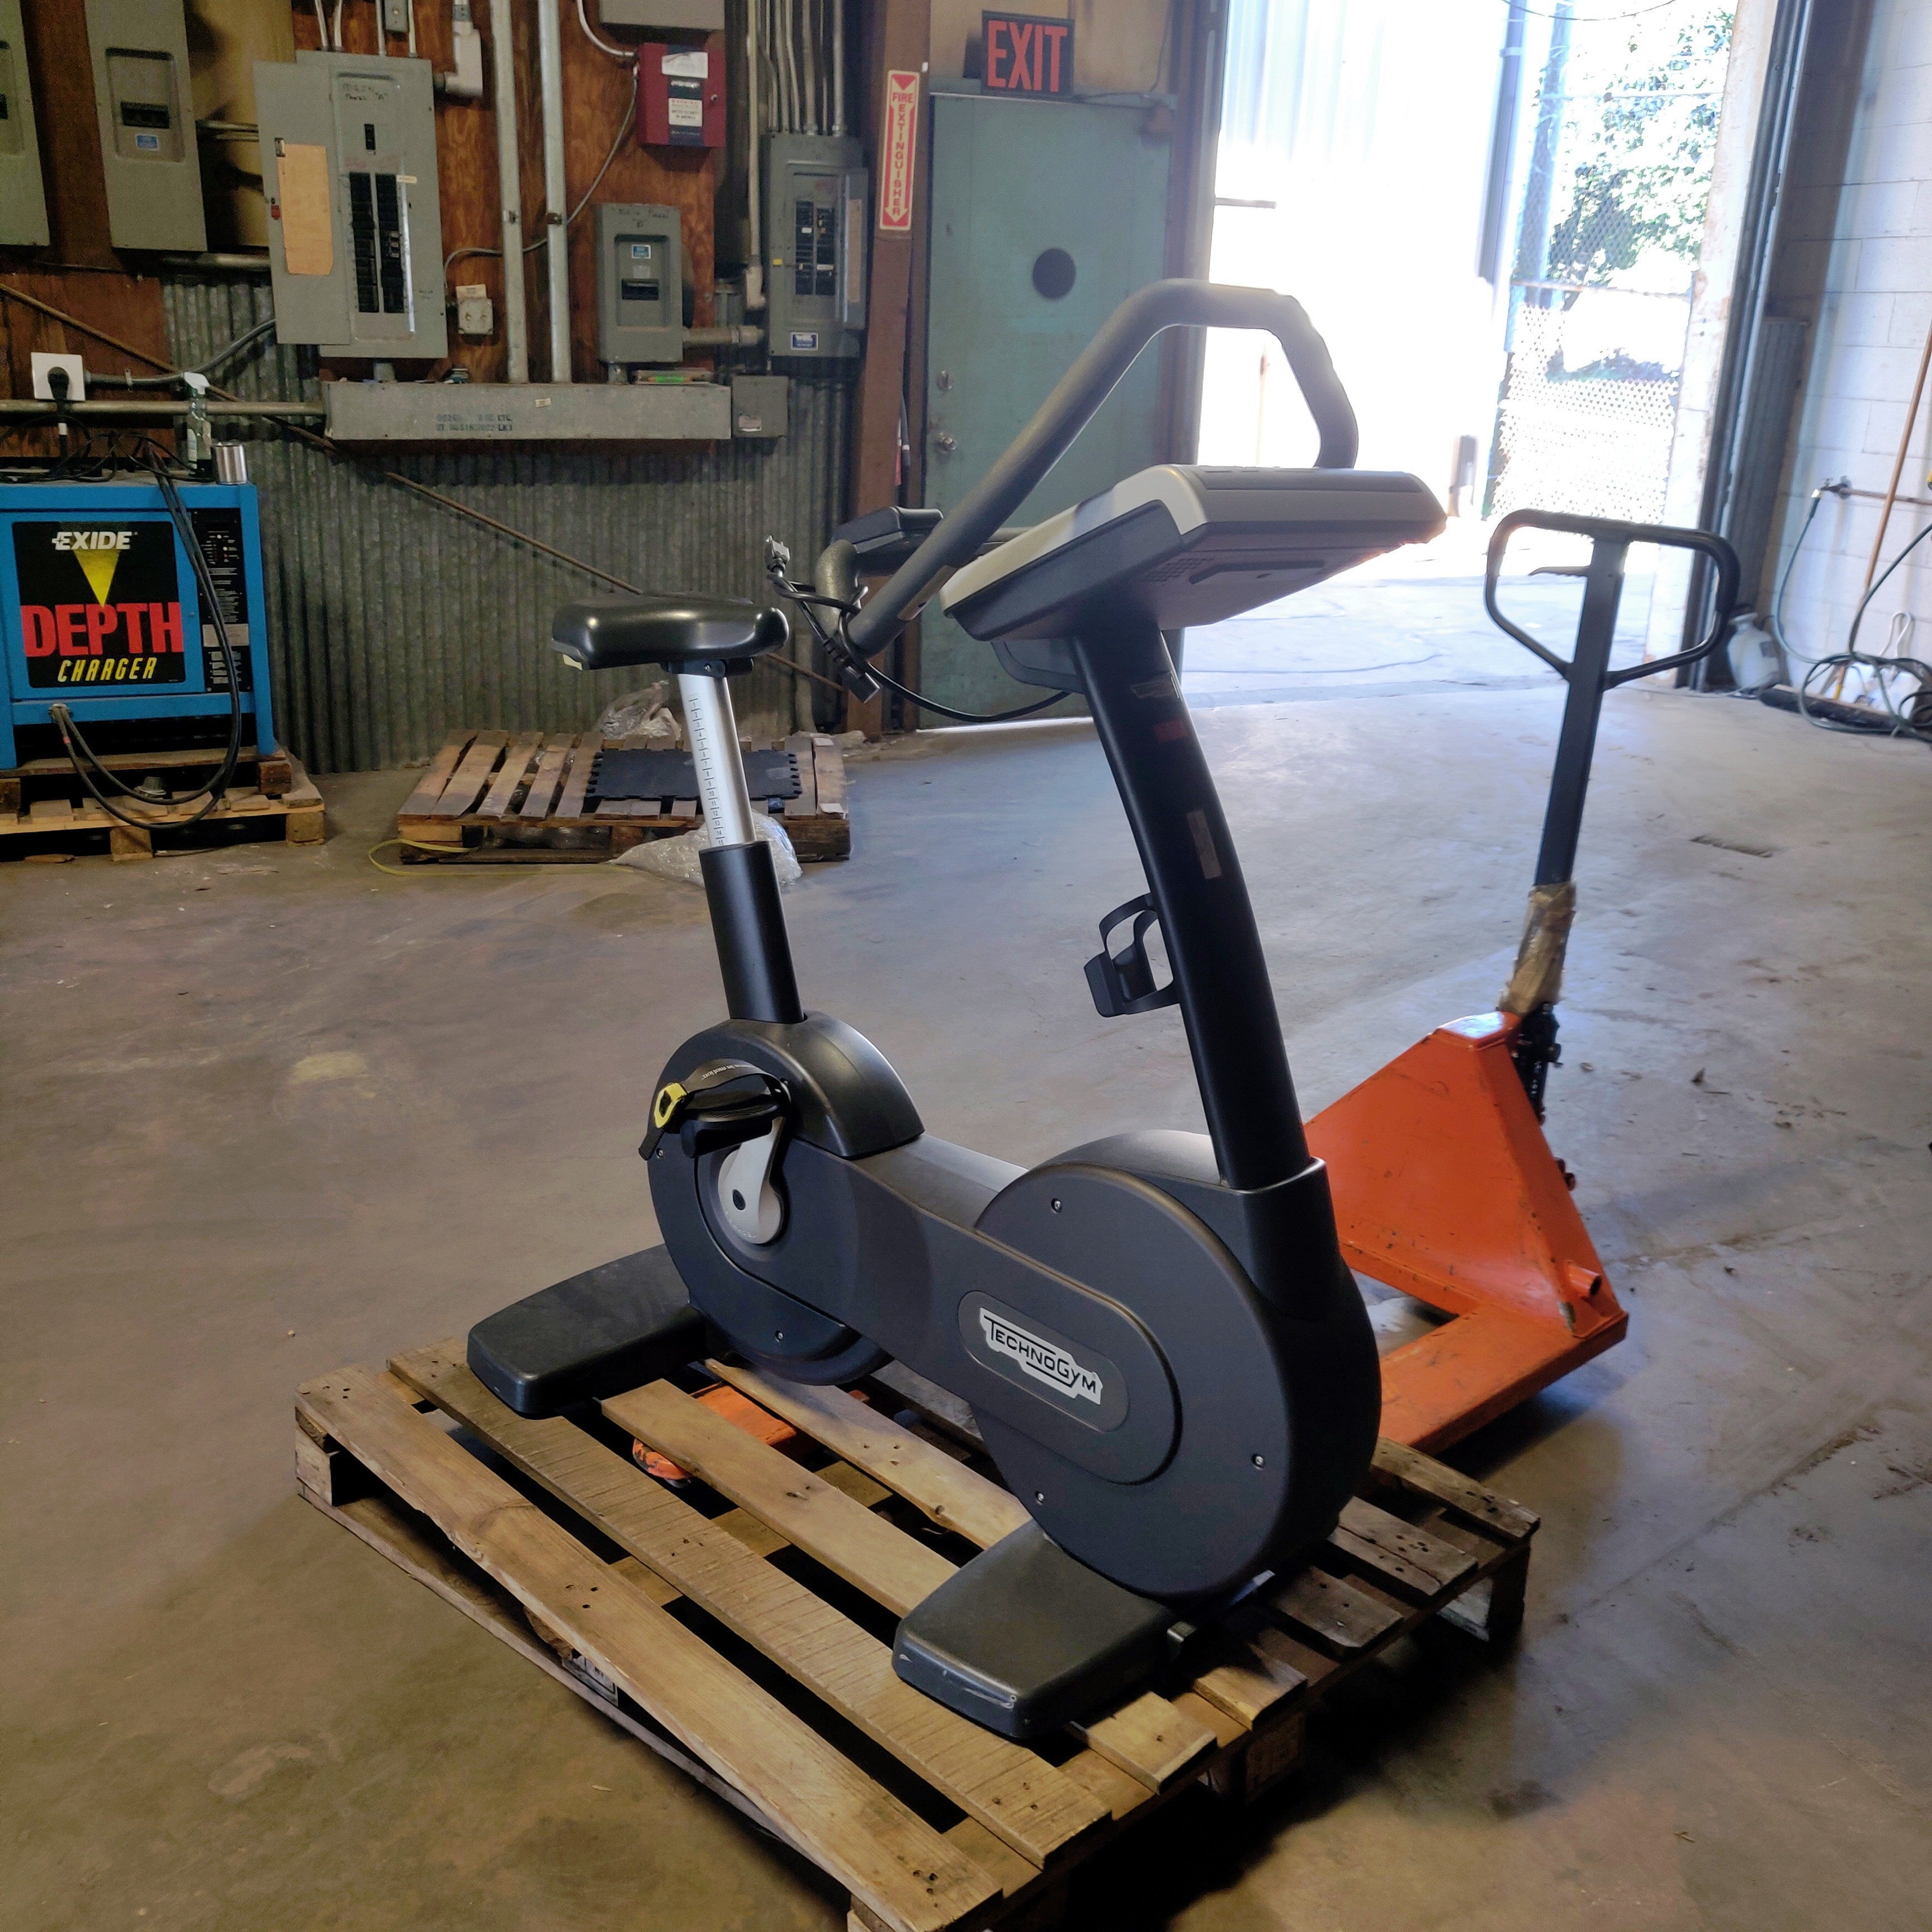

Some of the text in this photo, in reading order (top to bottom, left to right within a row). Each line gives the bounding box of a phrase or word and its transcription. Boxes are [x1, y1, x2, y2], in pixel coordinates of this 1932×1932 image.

[987, 21, 1068, 92] EXIT
[892, 93, 913, 103] FIRE
[892, 104, 906, 215] EXTINGUISHER
[52, 532, 132, 550] EXIDE
[21, 602, 184, 657] DEPTH
[58, 657, 157, 682] CHARGER
